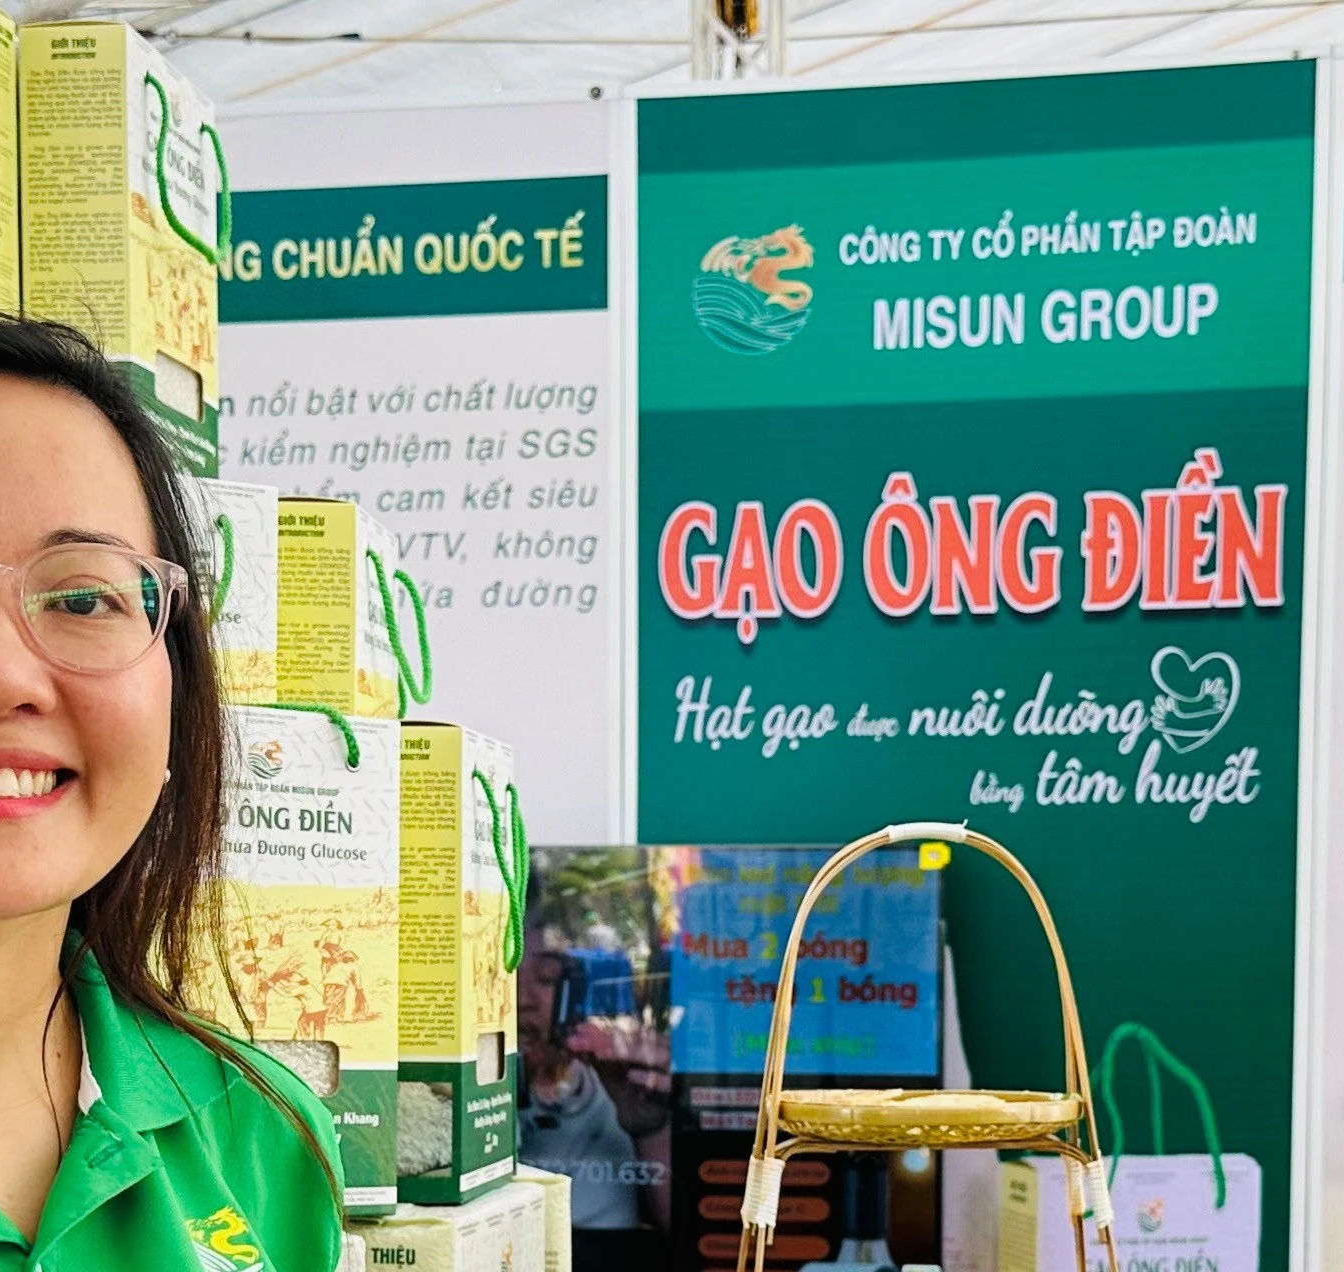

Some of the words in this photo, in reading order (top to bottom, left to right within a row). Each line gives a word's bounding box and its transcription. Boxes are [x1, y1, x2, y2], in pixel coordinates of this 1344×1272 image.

[838, 224, 921, 266] CÔNG
[928, 229, 964, 261] TY
[971, 209, 1015, 260] CỔ
[1021, 209, 1101, 257] PHẦN
[1109, 210, 1166, 257] TẬP
[1172, 206, 1257, 248] ĐOÀN
[872, 292, 1025, 351] MISUN
[1040, 282, 1219, 344] GROUP
[657, 500, 845, 645] GẠO
[862, 470, 1063, 620] ÔNG
[1079, 446, 1288, 615] ĐIỀN
[673, 674, 755, 751] Hạt
[761, 702, 839, 759] gạo
[907, 688, 1006, 738] nuôi
[1012, 671, 1152, 755] dưỡng
[969, 769, 1025, 814] bằng
[1035, 749, 1126, 806] tâm
[1134, 739, 1262, 824] huyết
[238, 798, 290, 830] ÔNG
[311, 843, 367, 861] Glucose
[682, 932, 748, 960] Mua
[760, 932, 778, 959] 2
[725, 975, 797, 1007] tặn
[811, 977, 826, 1003] 1
[838, 974, 918, 1009] bóng
[344, 1112, 379, 1126] Khang
[371, 1245, 416, 1269] THIỆU
